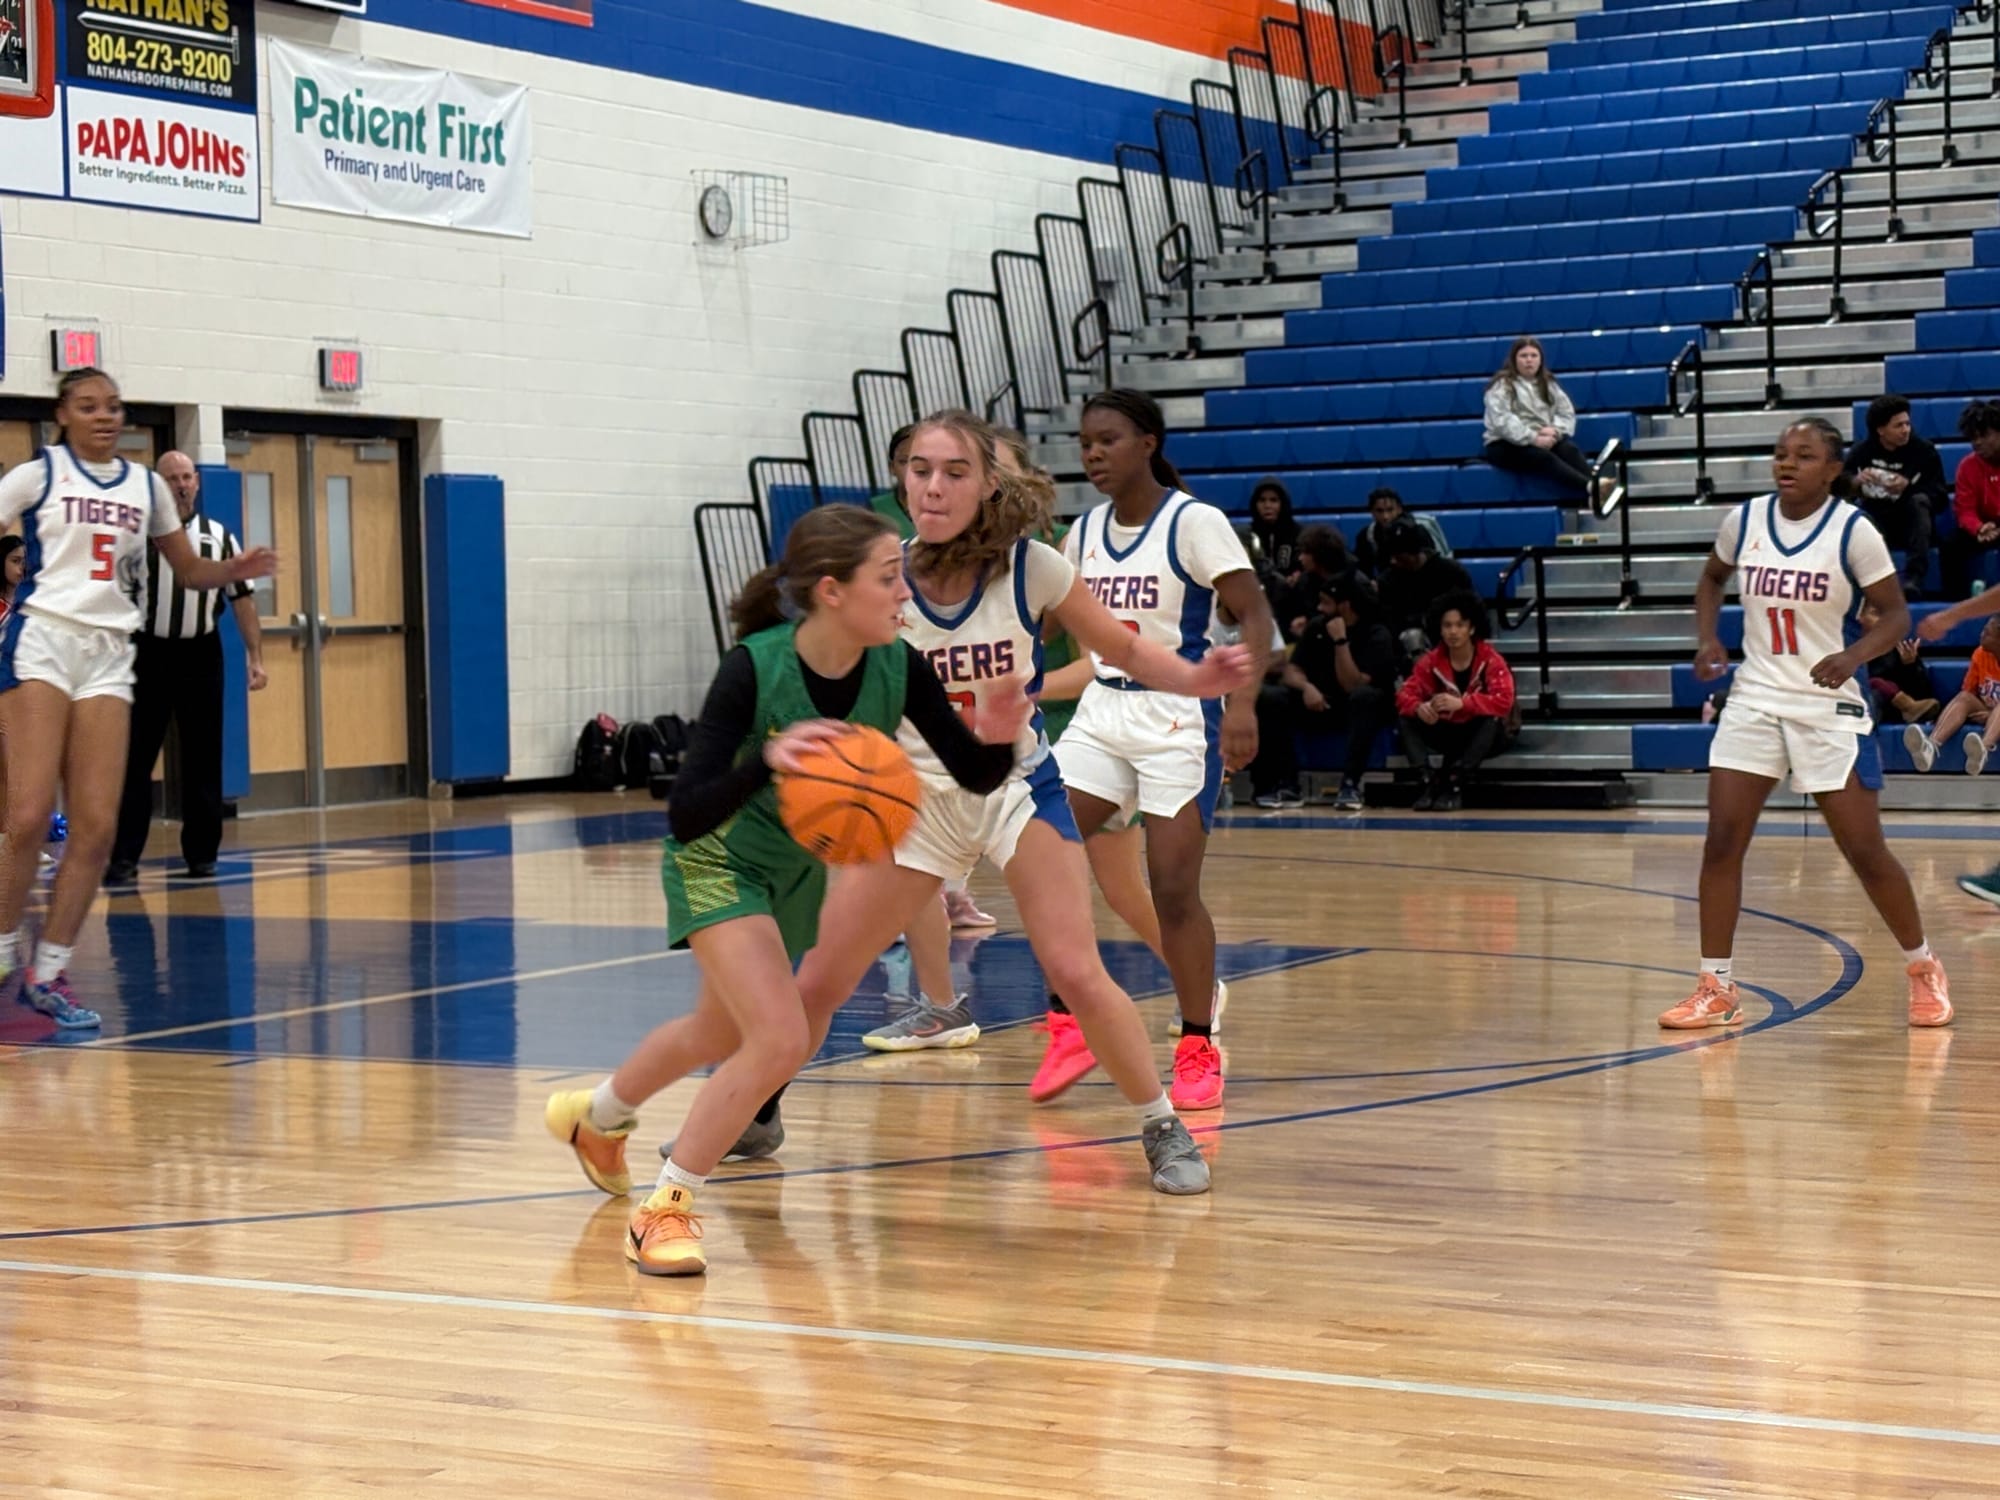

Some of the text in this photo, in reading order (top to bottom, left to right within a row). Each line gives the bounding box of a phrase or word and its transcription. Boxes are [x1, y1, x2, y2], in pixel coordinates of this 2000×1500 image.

[86, 0, 230, 32] THAN'S
[87, 31, 232, 83] 804-273-9200
[86, 63, 233, 98] NATHANSROOFREPAIRS.COM
[294, 76, 507, 167] Patient First
[77, 117, 246, 178] PAPA JOHNS
[78, 161, 248, 196] Better Ingredients. Better Pizza.
[324, 148, 486, 194] Primary and Urgent Care
[62, 496, 143, 535] TIGERS
[90, 533, 117, 581] 5
[1743, 564, 1830, 602] TIGERS
[1766, 606, 1799, 656] 11
[918, 639, 1014, 684] GERS
